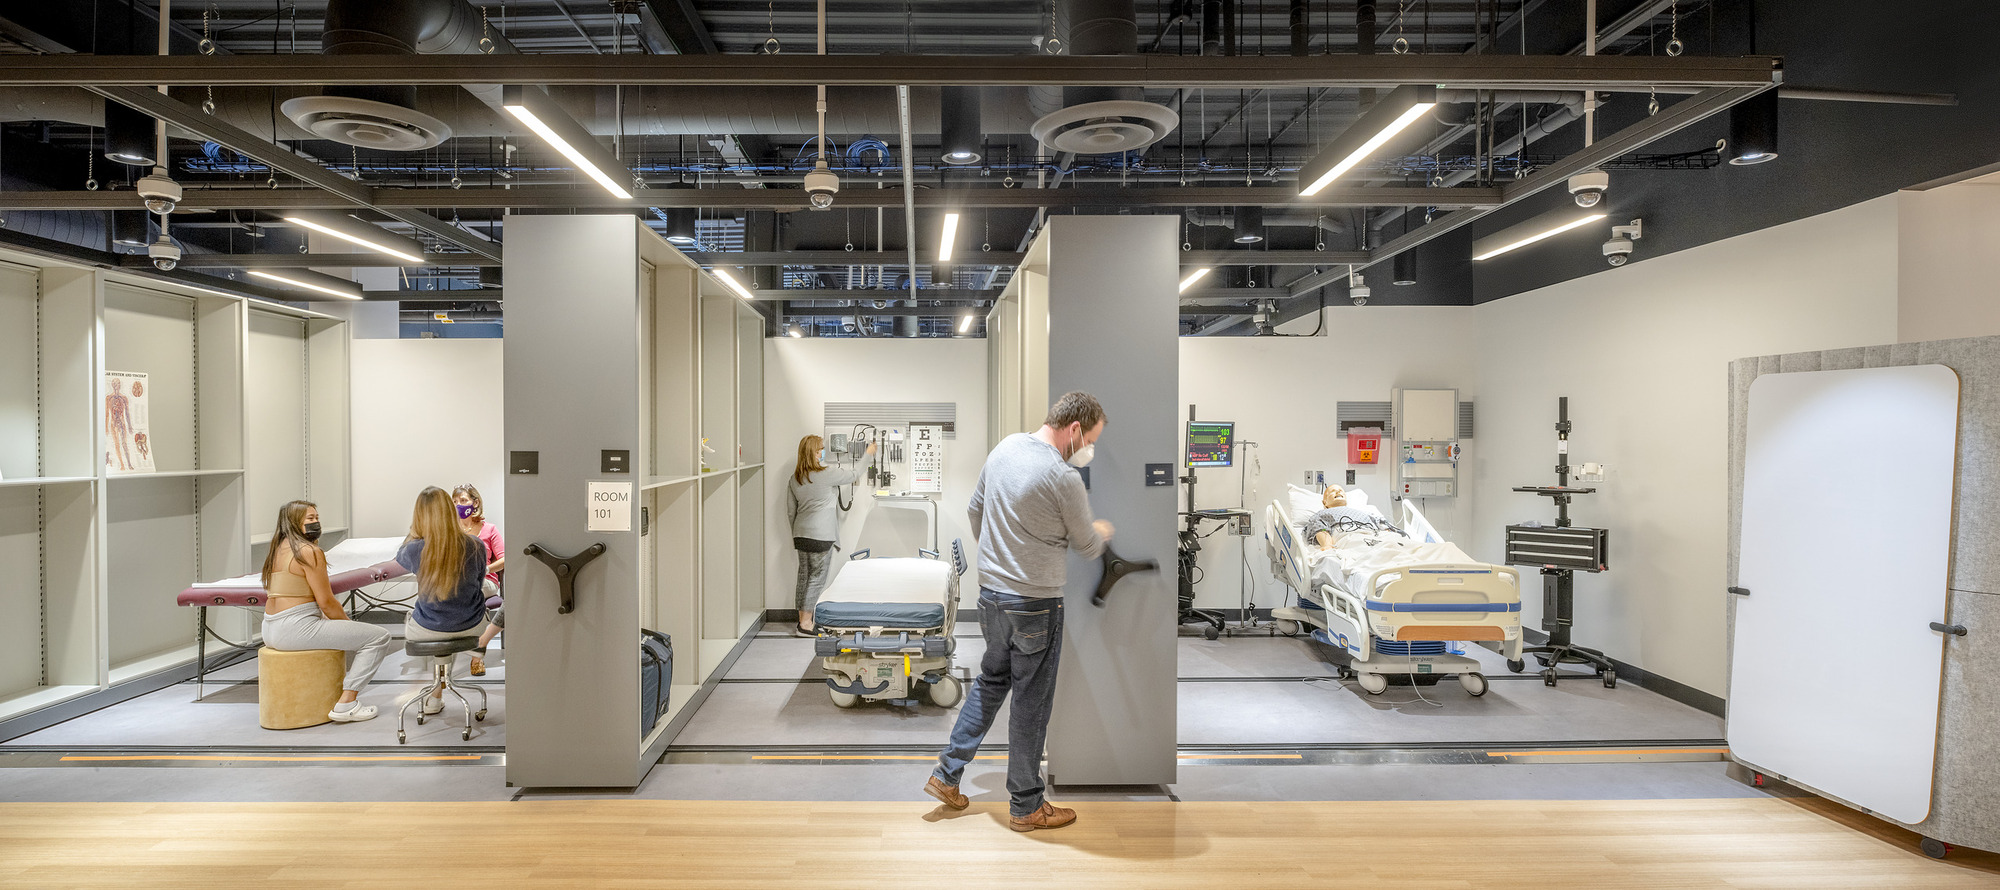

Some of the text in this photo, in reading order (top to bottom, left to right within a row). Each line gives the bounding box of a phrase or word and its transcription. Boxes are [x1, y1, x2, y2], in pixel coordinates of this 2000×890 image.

[919, 429, 930, 440] E
[594, 492, 628, 501] ROOM
[595, 509, 611, 518] 101
